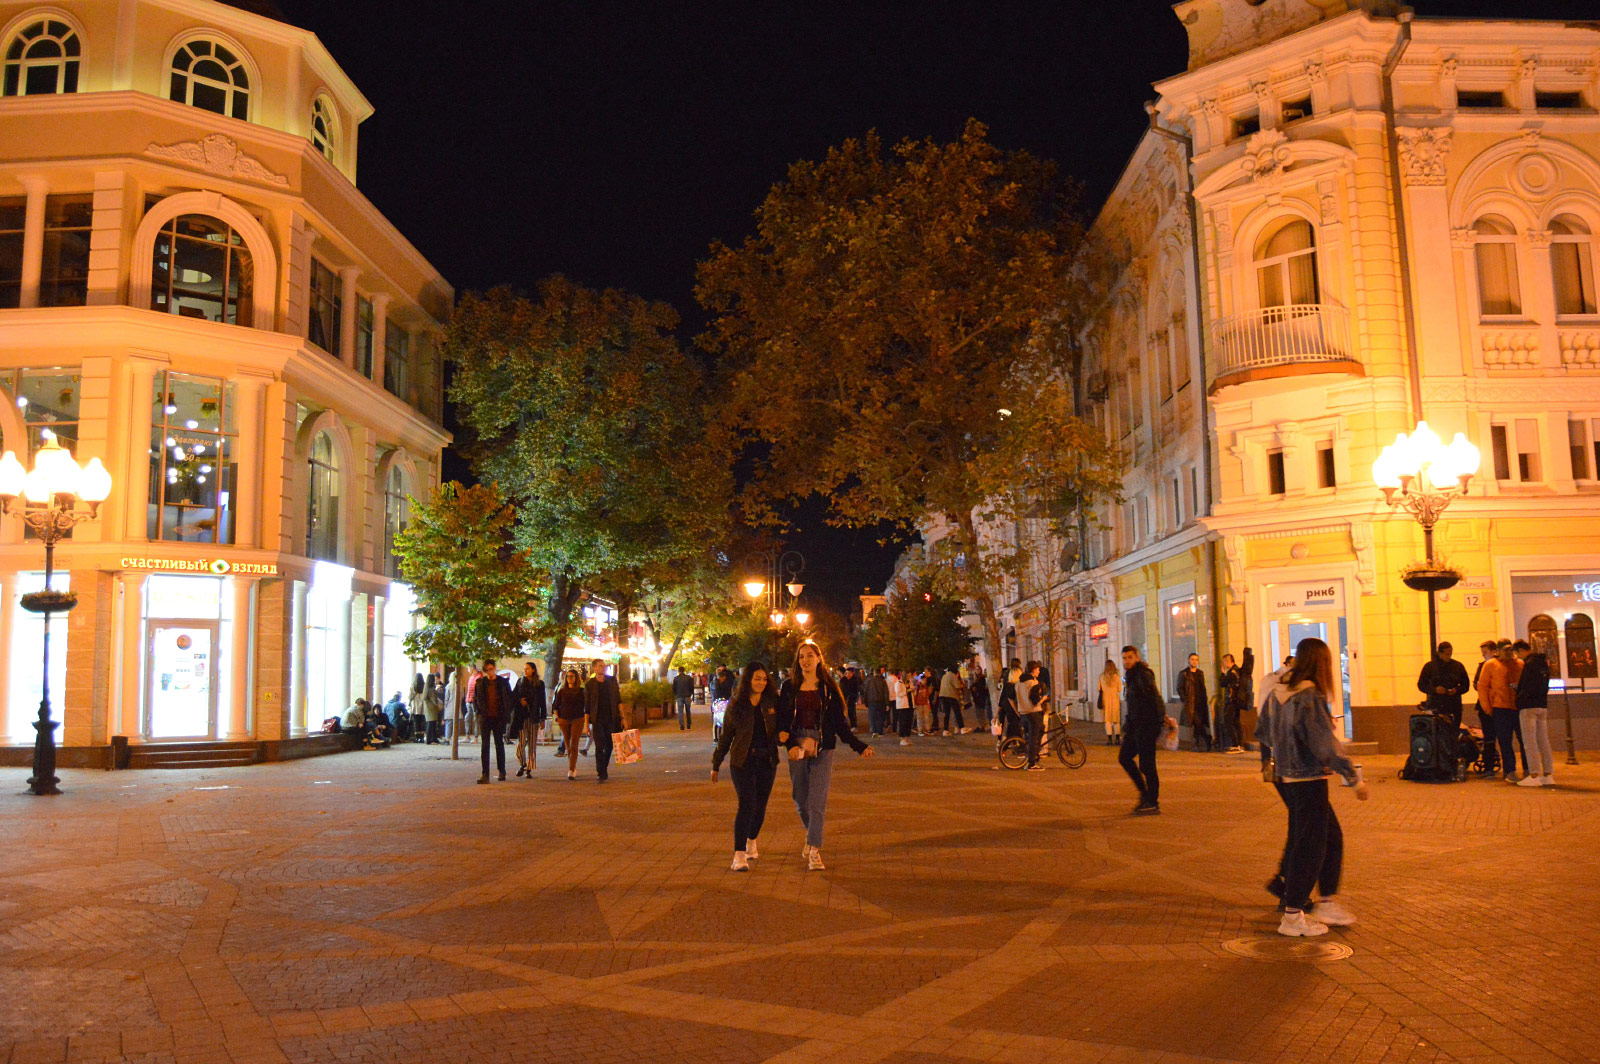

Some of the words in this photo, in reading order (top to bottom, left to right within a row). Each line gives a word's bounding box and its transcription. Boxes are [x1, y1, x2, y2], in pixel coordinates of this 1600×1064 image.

[120, 557, 209, 571] счастливый
[232, 562, 278, 574] взгляд
[1306, 586, 1335, 599] рнкб
[1467, 596, 1479, 606] 12
